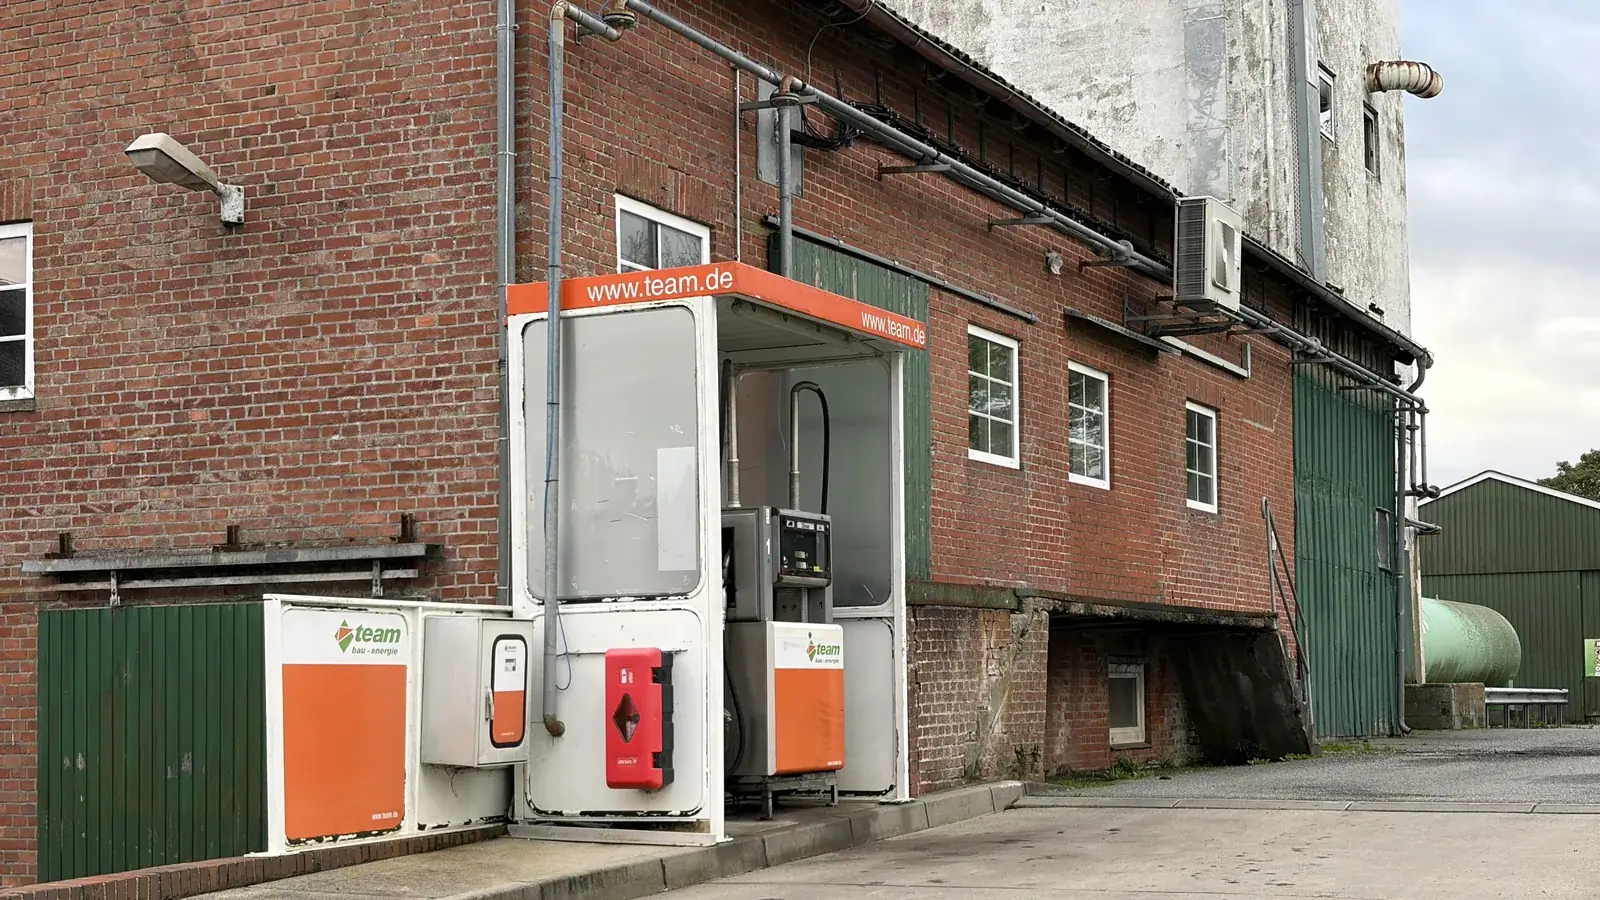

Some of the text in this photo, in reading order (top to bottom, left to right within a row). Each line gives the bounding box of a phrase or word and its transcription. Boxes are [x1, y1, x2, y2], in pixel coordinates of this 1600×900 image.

[586, 267, 733, 302] www.team.de
[861, 311, 925, 345] www.team.de
[766, 538, 770, 555] 1
[355, 624, 401, 643] team
[352, 646, 398, 656] bau energie
[816, 643, 840, 655] team
